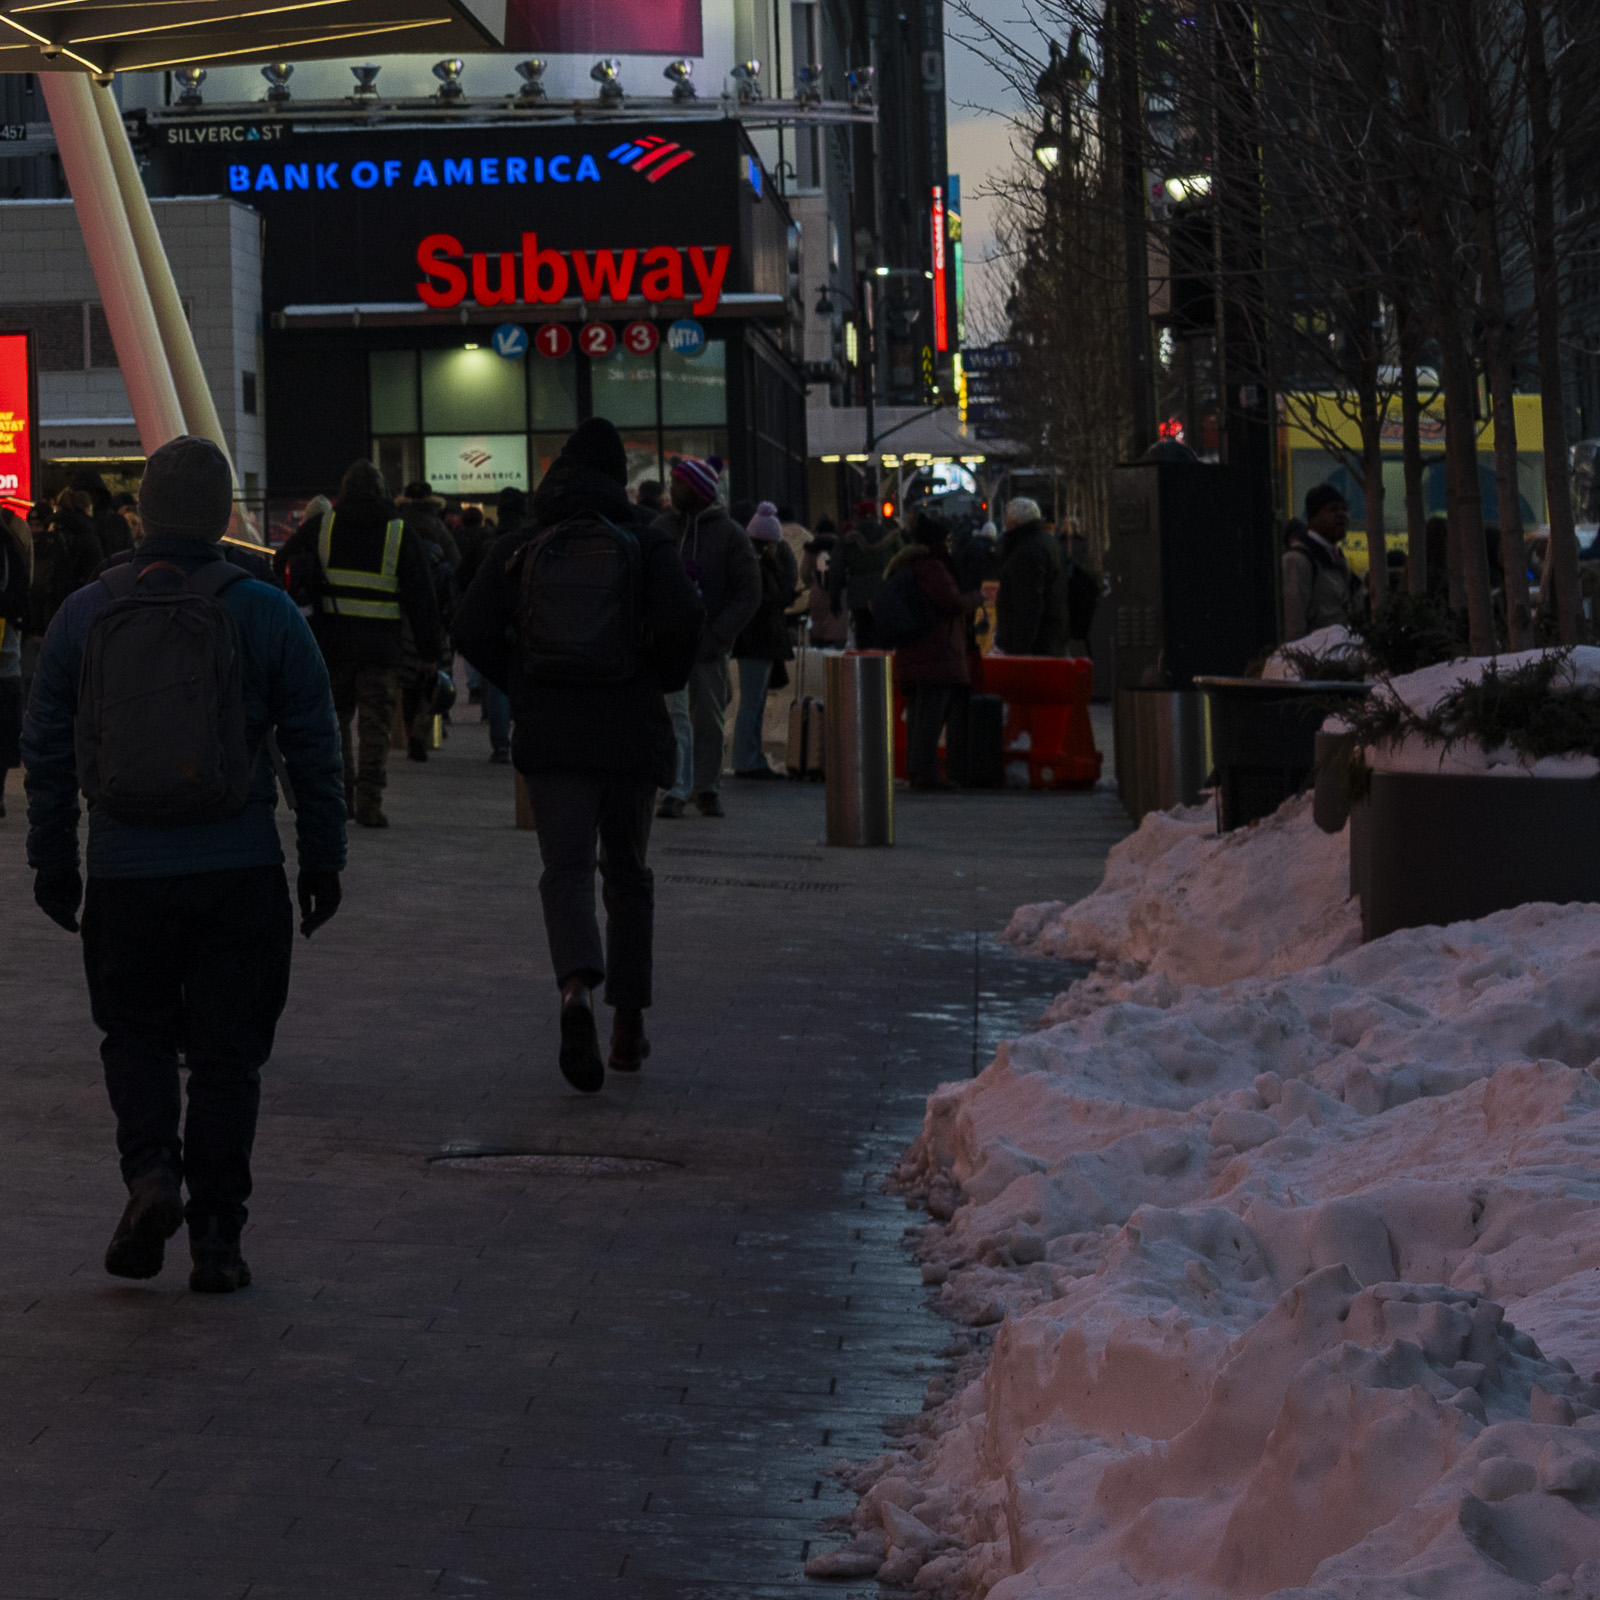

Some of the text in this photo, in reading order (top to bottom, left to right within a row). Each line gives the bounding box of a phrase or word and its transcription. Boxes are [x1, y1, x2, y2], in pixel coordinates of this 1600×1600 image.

[167, 124, 285, 145] SILVERCAST
[228, 153, 601, 193] BANK OF AMERICA
[415, 231, 732, 316] Subway
[545, 325, 651, 353] 1 2 3
